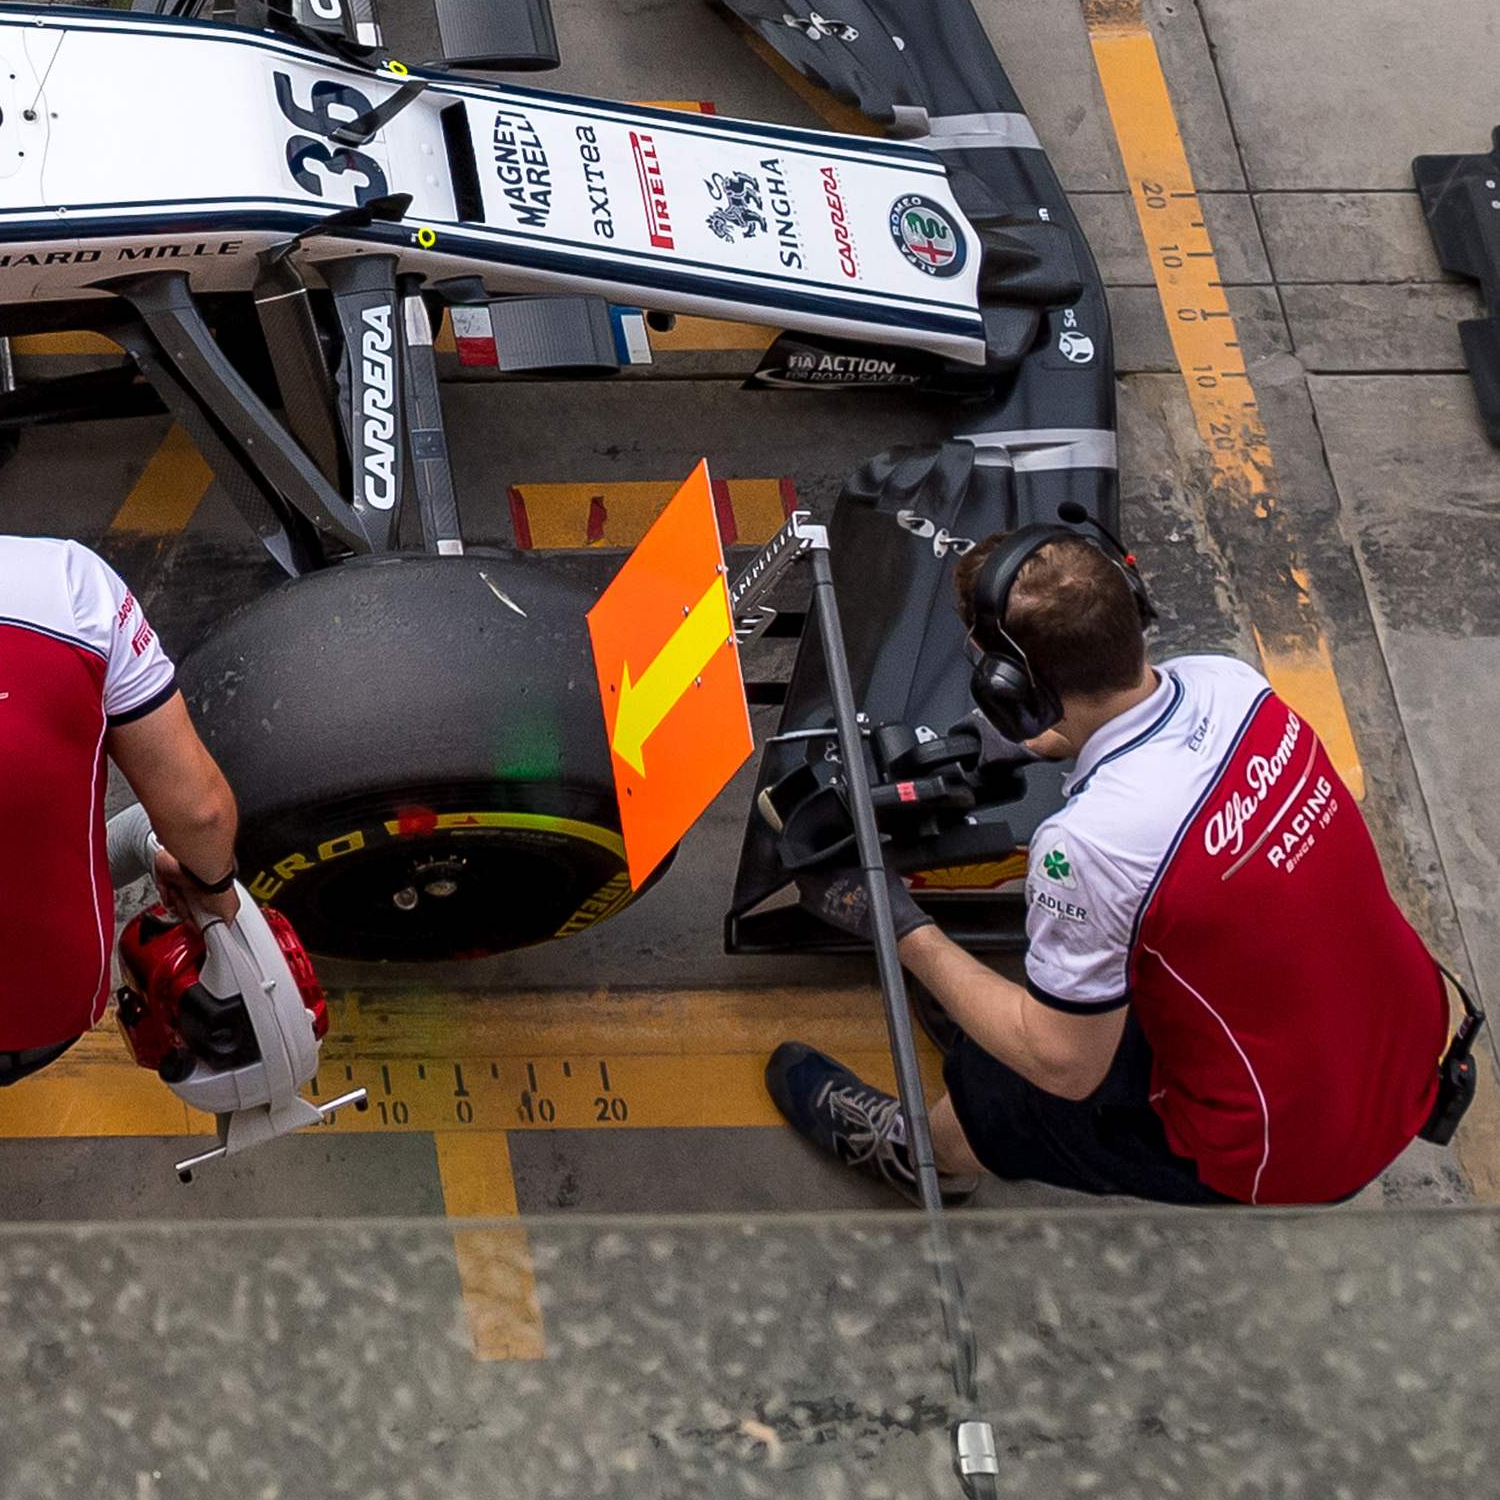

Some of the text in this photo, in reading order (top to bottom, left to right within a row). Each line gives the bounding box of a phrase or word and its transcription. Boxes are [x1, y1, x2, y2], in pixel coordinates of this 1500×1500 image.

[272, 71, 389, 208] 36
[628, 130, 676, 251] PIRELLI
[1142, 180, 1167, 210] 20
[759, 157, 803, 270] SINGHA
[819, 166, 857, 278] CARRERA
[890, 196, 922, 237] ROMEO
[117, 240, 244, 261] MILLE
[1159, 244, 1183, 269] 10
[788, 355, 896, 374] FIA ACTION
[809, 371, 856, 381] ROAD
[1192, 364, 1217, 389] 10
[361, 304, 396, 510] CARRERA
[1204, 709, 1301, 856] Alfa Romeo
[1266, 775, 1332, 869] RACING
[247, 830, 366, 903] ERO
[1037, 892, 1088, 920] ADLER
[376, 1100, 410, 1126] 10
[593, 1097, 629, 1122] 20
